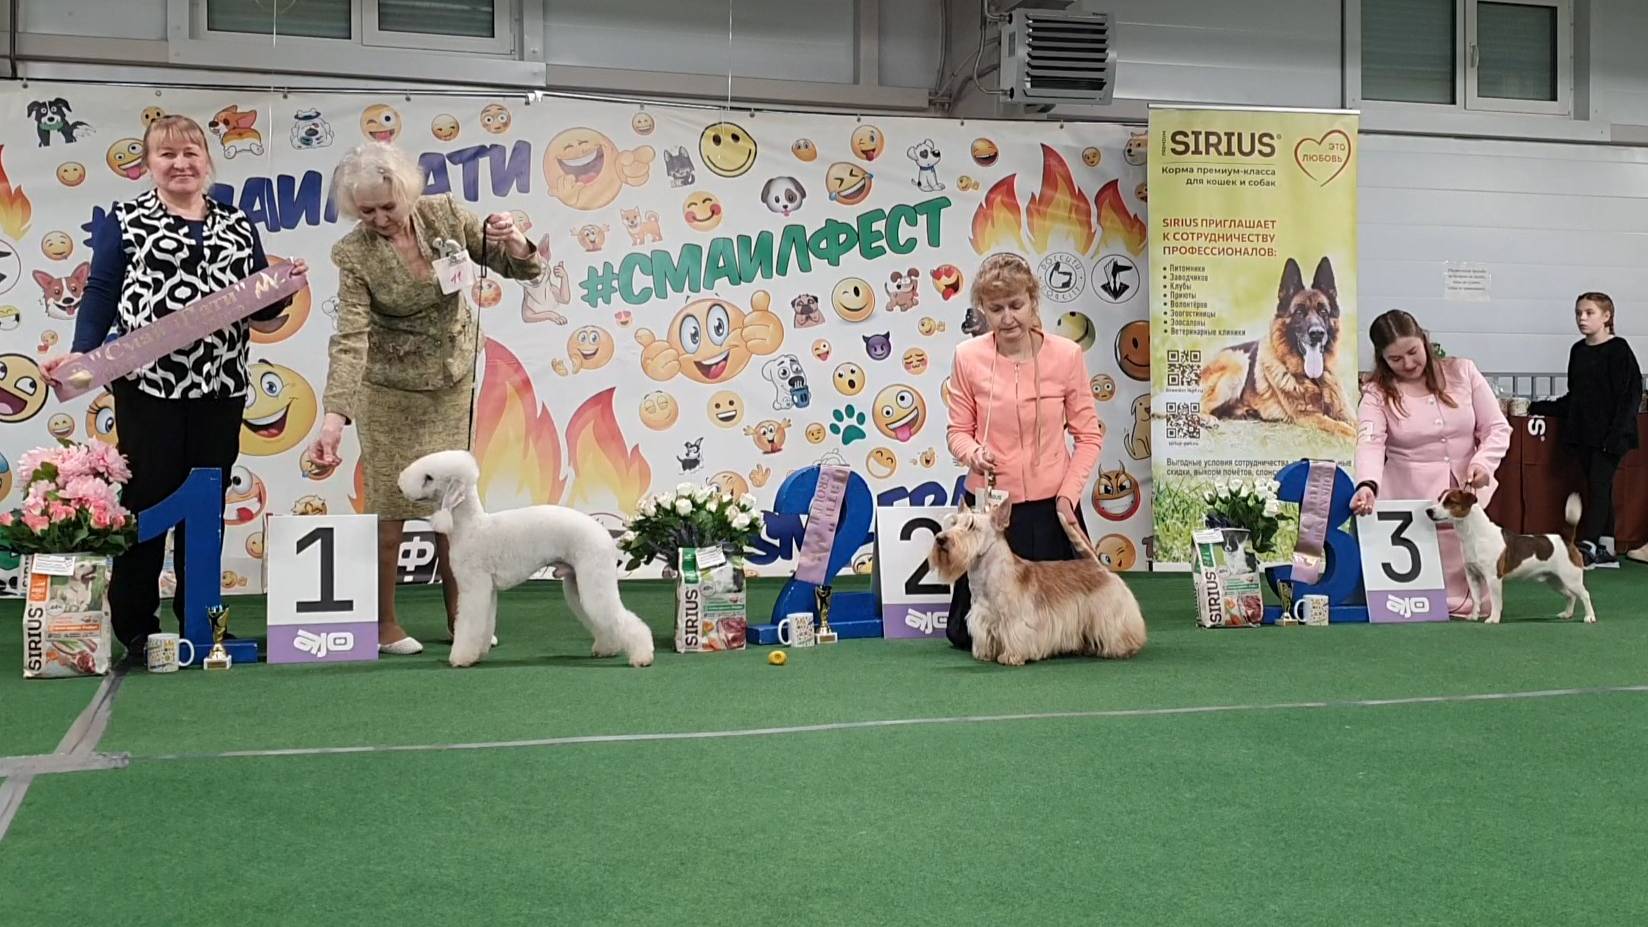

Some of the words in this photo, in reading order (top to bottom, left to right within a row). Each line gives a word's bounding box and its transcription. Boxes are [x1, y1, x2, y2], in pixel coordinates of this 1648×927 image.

[1170, 130, 1276, 158] SIRIUS
[1328, 143, 1346, 151] ЭТО
[1302, 154, 1343, 163] ЛЮБОВЬ
[1161, 166, 1194, 175] Корма
[1196, 167, 1276, 177] премиум-класса
[1185, 178, 1204, 186] для
[1206, 178, 1237, 186] кошек
[1248, 178, 1276, 187] собак
[1162, 218, 1199, 228] SIRIUS
[1200, 218, 1277, 230] ПРИГЛАШАЕТ
[1162, 232, 1170, 241] К
[1172, 231, 1276, 243] СОТРУДНИЧЕСТВУ
[1162, 246, 1277, 257] ПРОФЕССИОНАЛОВ:
[1169, 282, 1192, 291] Клубы
[1170, 291, 1197, 300] Приюты
[1166, 457, 1202, 466] Выгодные
[1204, 459, 1233, 468] условия
[1166, 469, 1191, 477] скидки,
[1377, 511, 1422, 583] 3
[900, 517, 951, 596] 2
[296, 527, 354, 613] 1
[1205, 571, 1222, 624] SIRIUS
[685, 588, 699, 646] SIRIUS
[28, 607, 44, 671] SIRIUS
